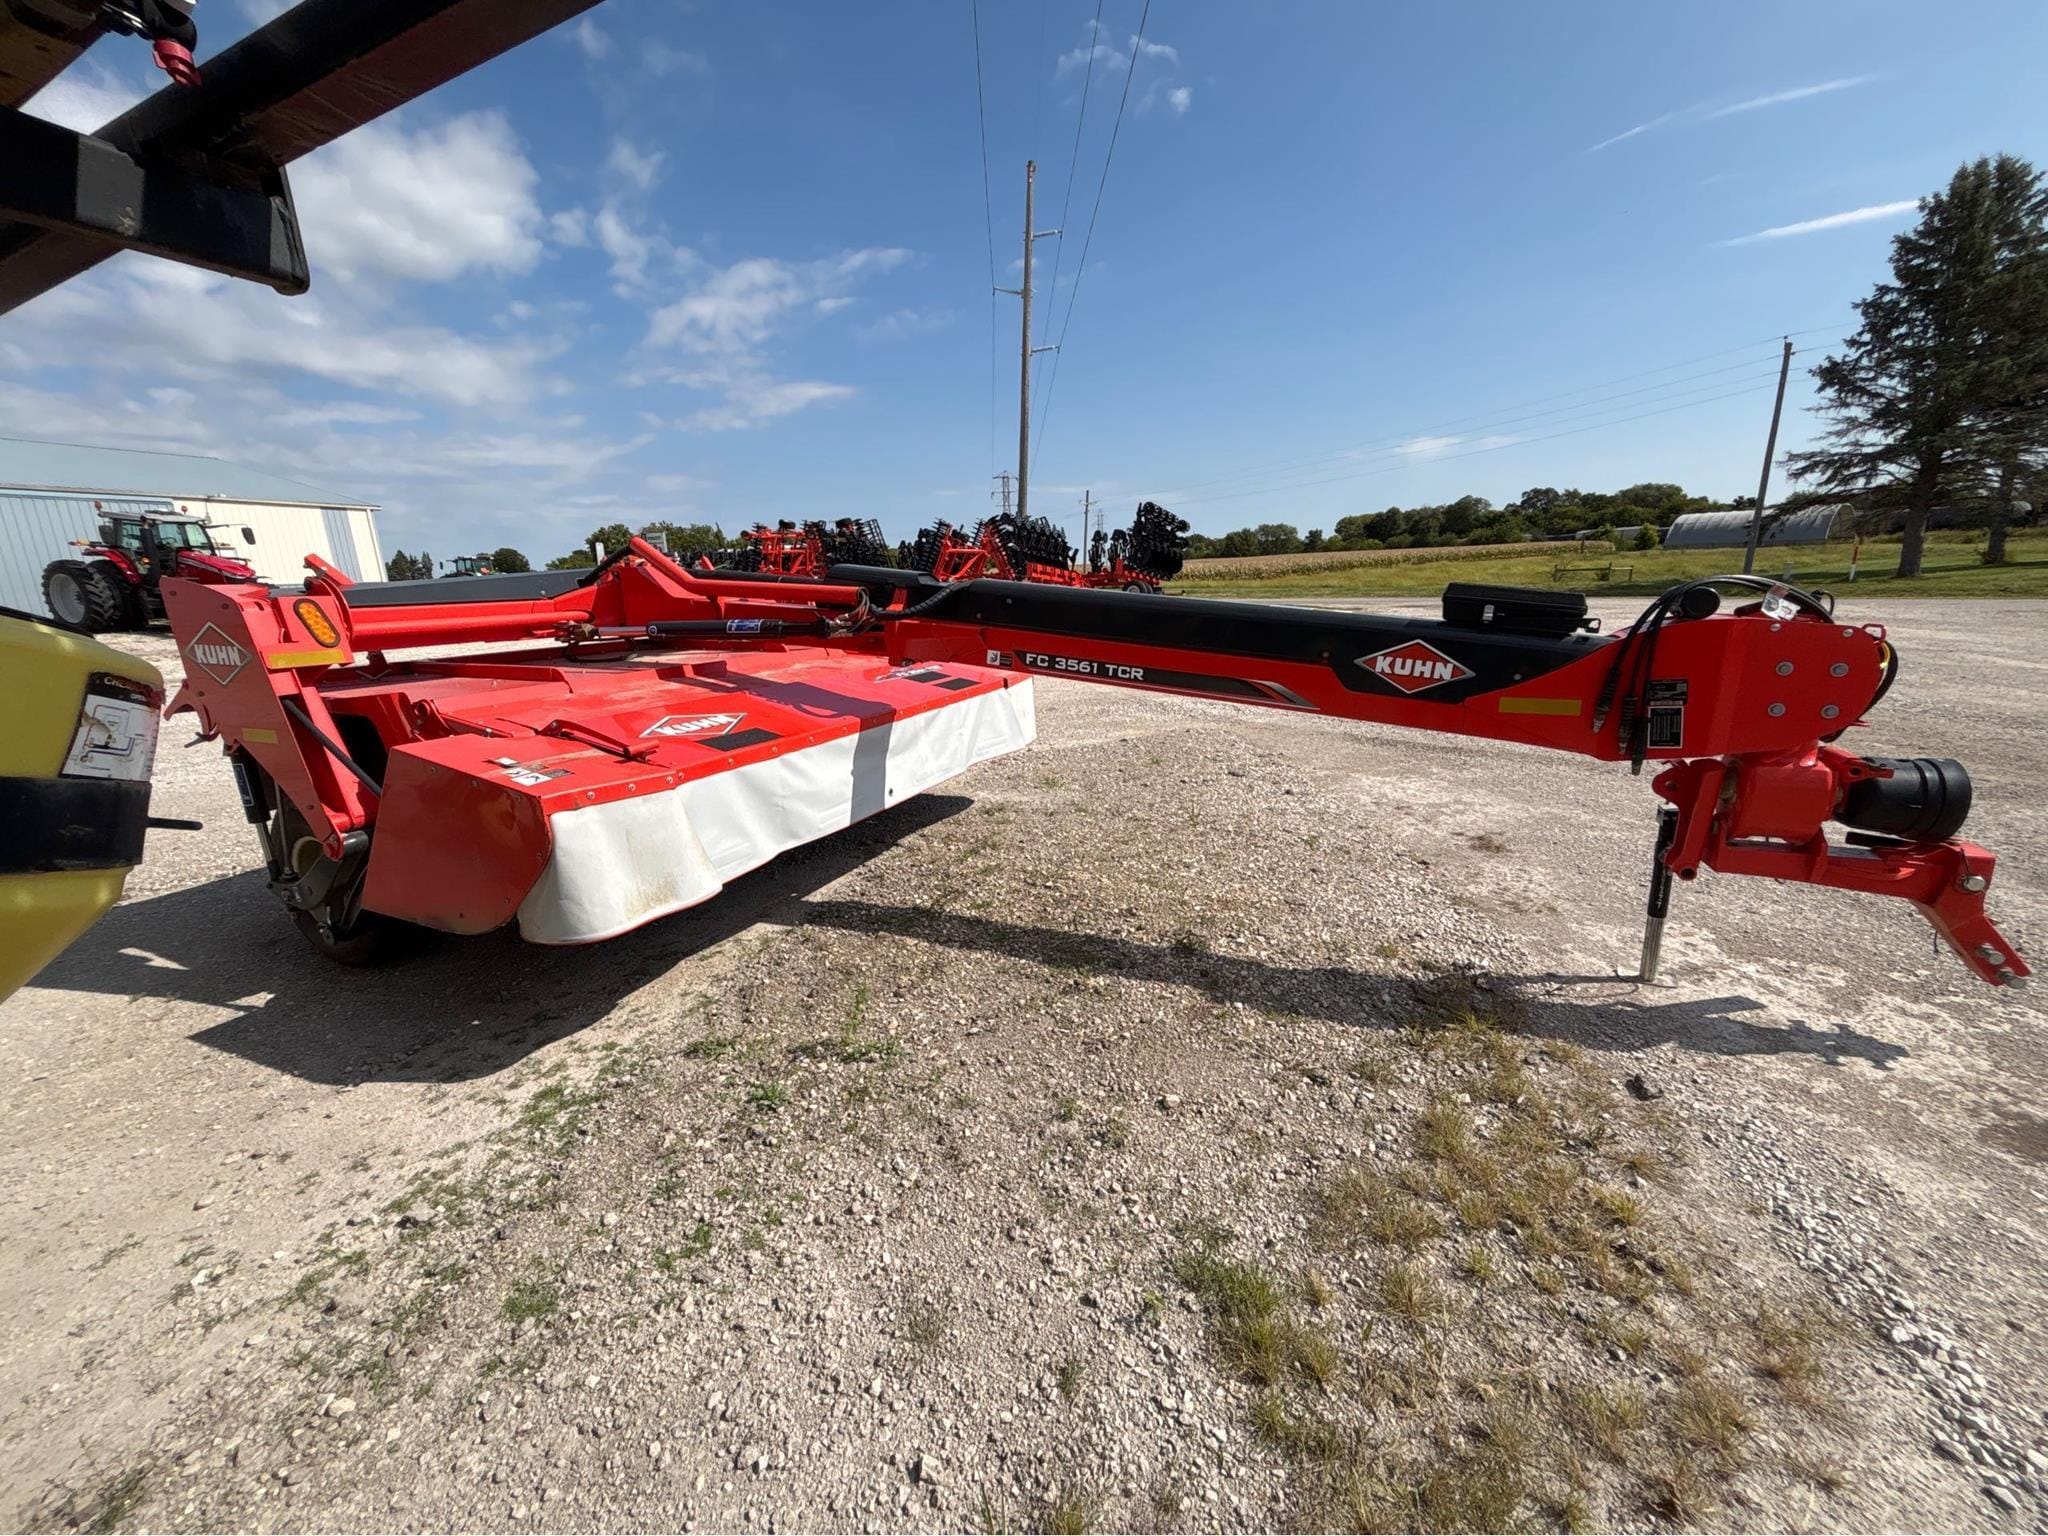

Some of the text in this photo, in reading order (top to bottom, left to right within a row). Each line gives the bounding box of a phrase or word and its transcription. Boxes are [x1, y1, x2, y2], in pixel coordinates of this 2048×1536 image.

[193, 644, 241, 666] KUHN
[1025, 653, 1144, 681] FC 3561 TCR
[1374, 655, 1454, 681] KUHN
[653, 714, 737, 735] KUHN
